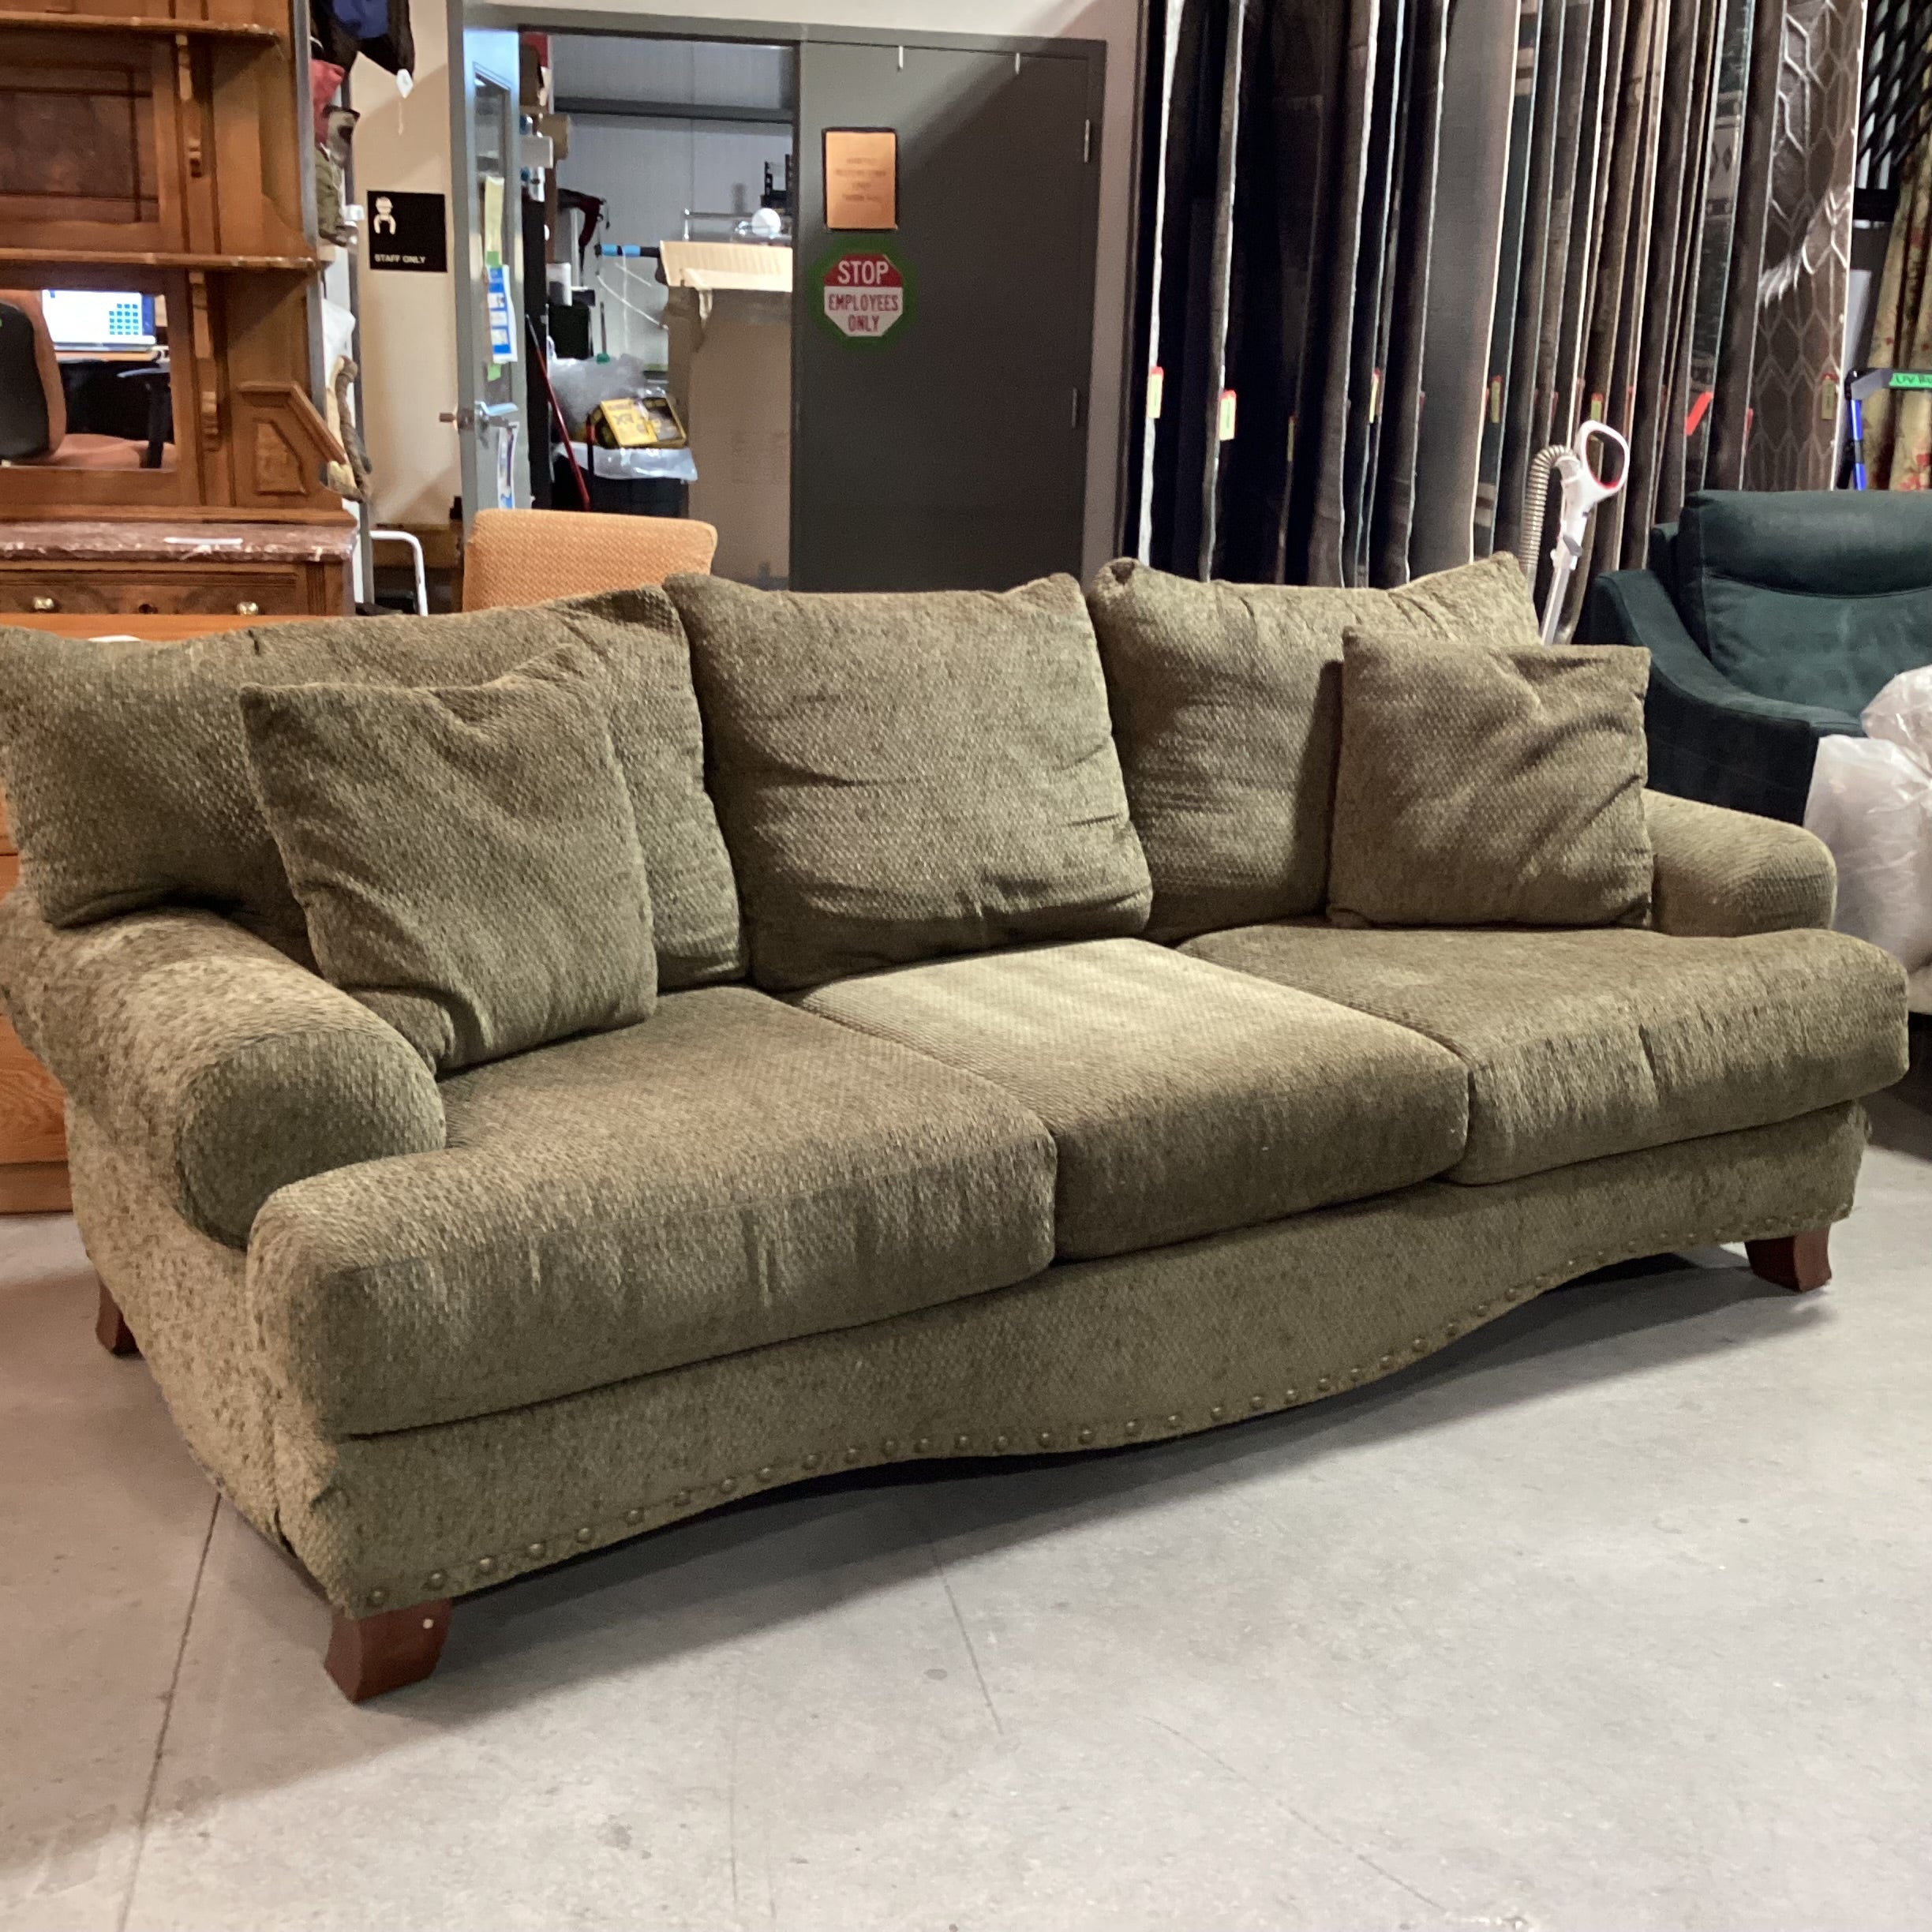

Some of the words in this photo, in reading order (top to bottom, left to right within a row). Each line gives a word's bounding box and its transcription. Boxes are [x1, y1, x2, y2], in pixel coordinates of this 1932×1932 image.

[374, 253, 401, 263] STAFF
[402, 255, 426, 264] ONLY
[837, 260, 889, 285] STOP
[828, 294, 899, 312] EMPLOYEES
[848, 314, 880, 332] ONLY
